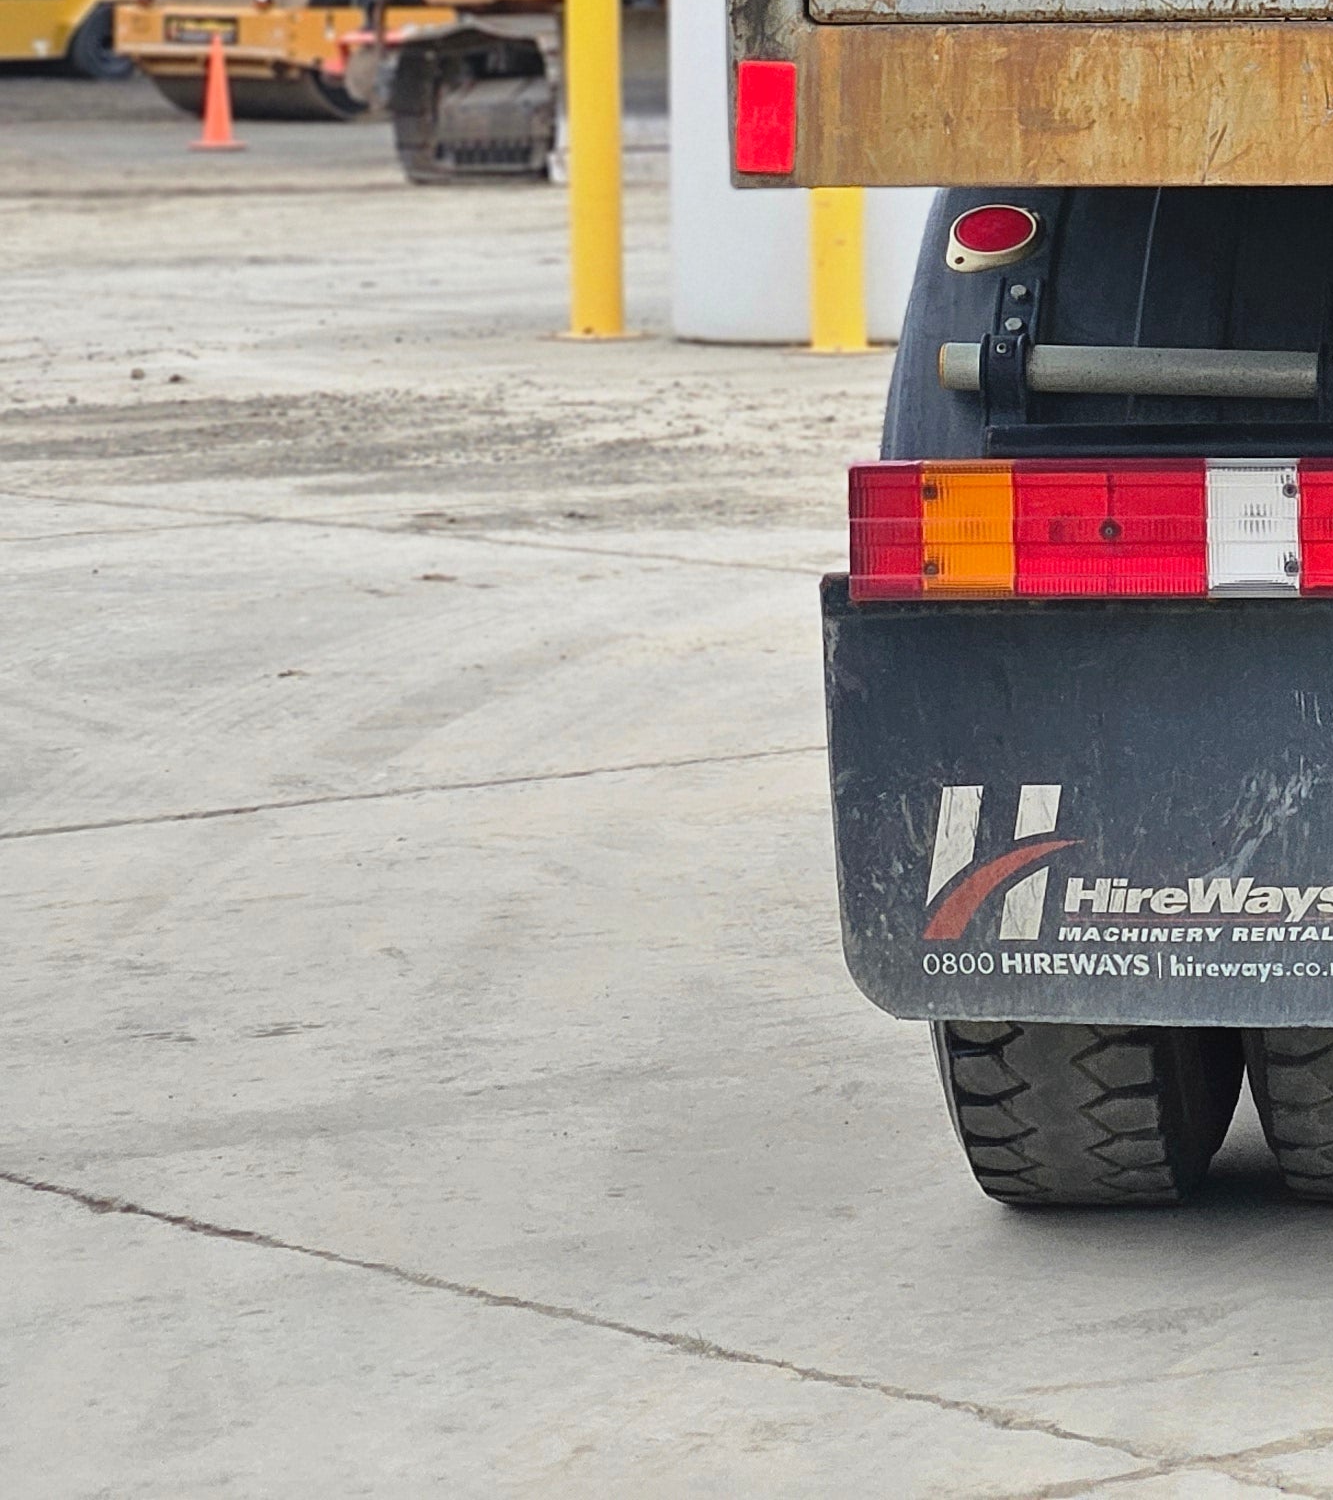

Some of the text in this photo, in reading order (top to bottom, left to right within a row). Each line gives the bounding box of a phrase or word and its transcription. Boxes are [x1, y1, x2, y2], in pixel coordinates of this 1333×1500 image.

[1058, 926, 1223, 942] MACHINERY
[923, 953, 994, 975] 0800
[1002, 953, 1150, 975] HIREWAYS
